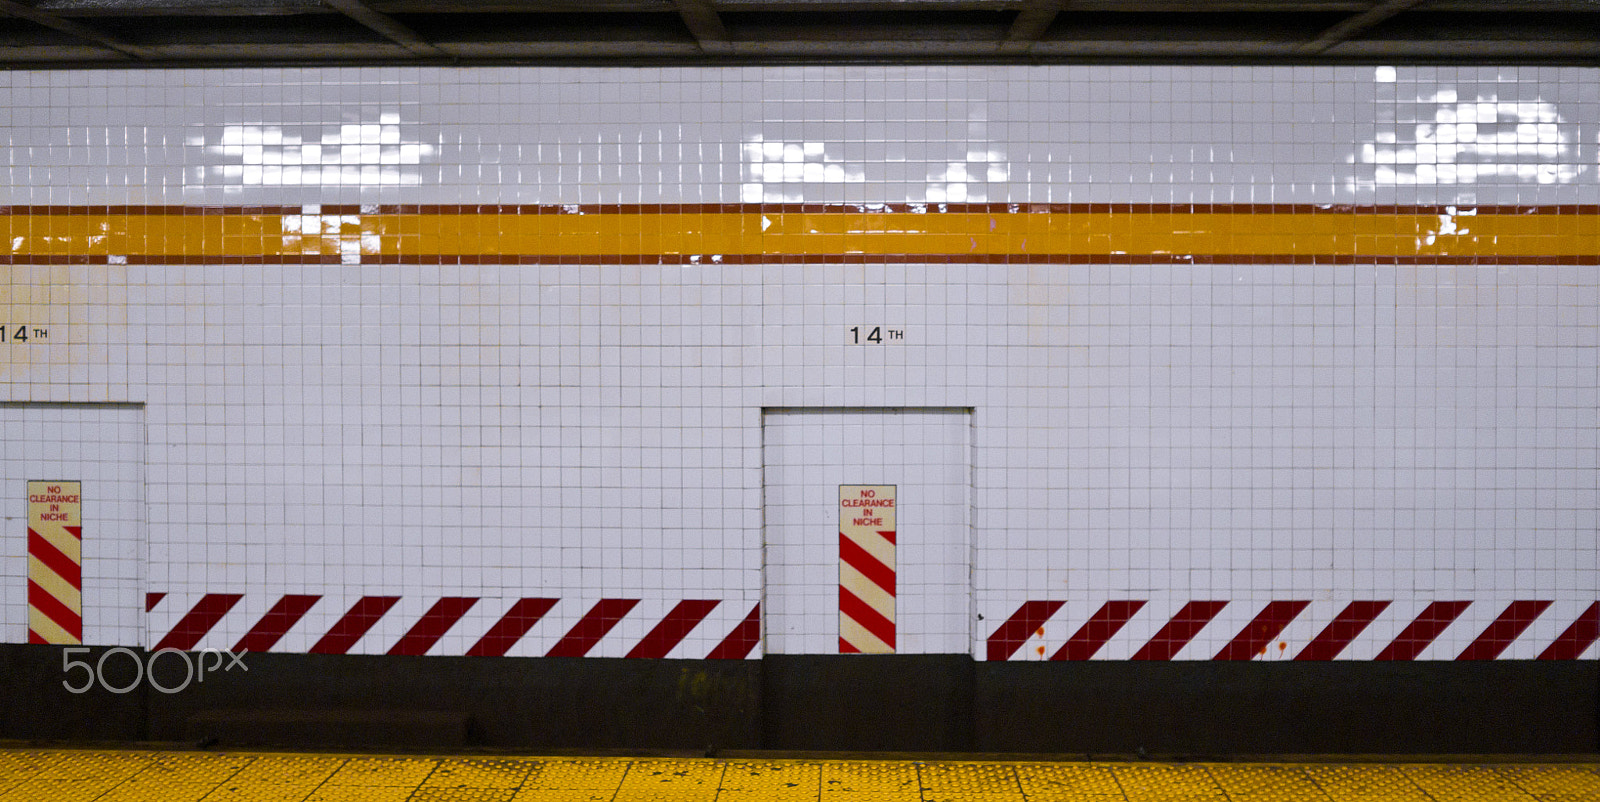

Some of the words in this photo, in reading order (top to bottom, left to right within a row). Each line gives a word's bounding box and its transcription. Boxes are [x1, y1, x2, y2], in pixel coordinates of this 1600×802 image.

[47, 485, 61, 494] NO
[860, 489, 876, 498] NO
[29, 494, 79, 503] CLEARANCE
[841, 498, 895, 508] CLEARANCE
[49, 504, 59, 512] IN
[863, 508, 873, 516] IN
[40, 513, 68, 521] NICHE
[852, 517, 883, 526] NICHE
